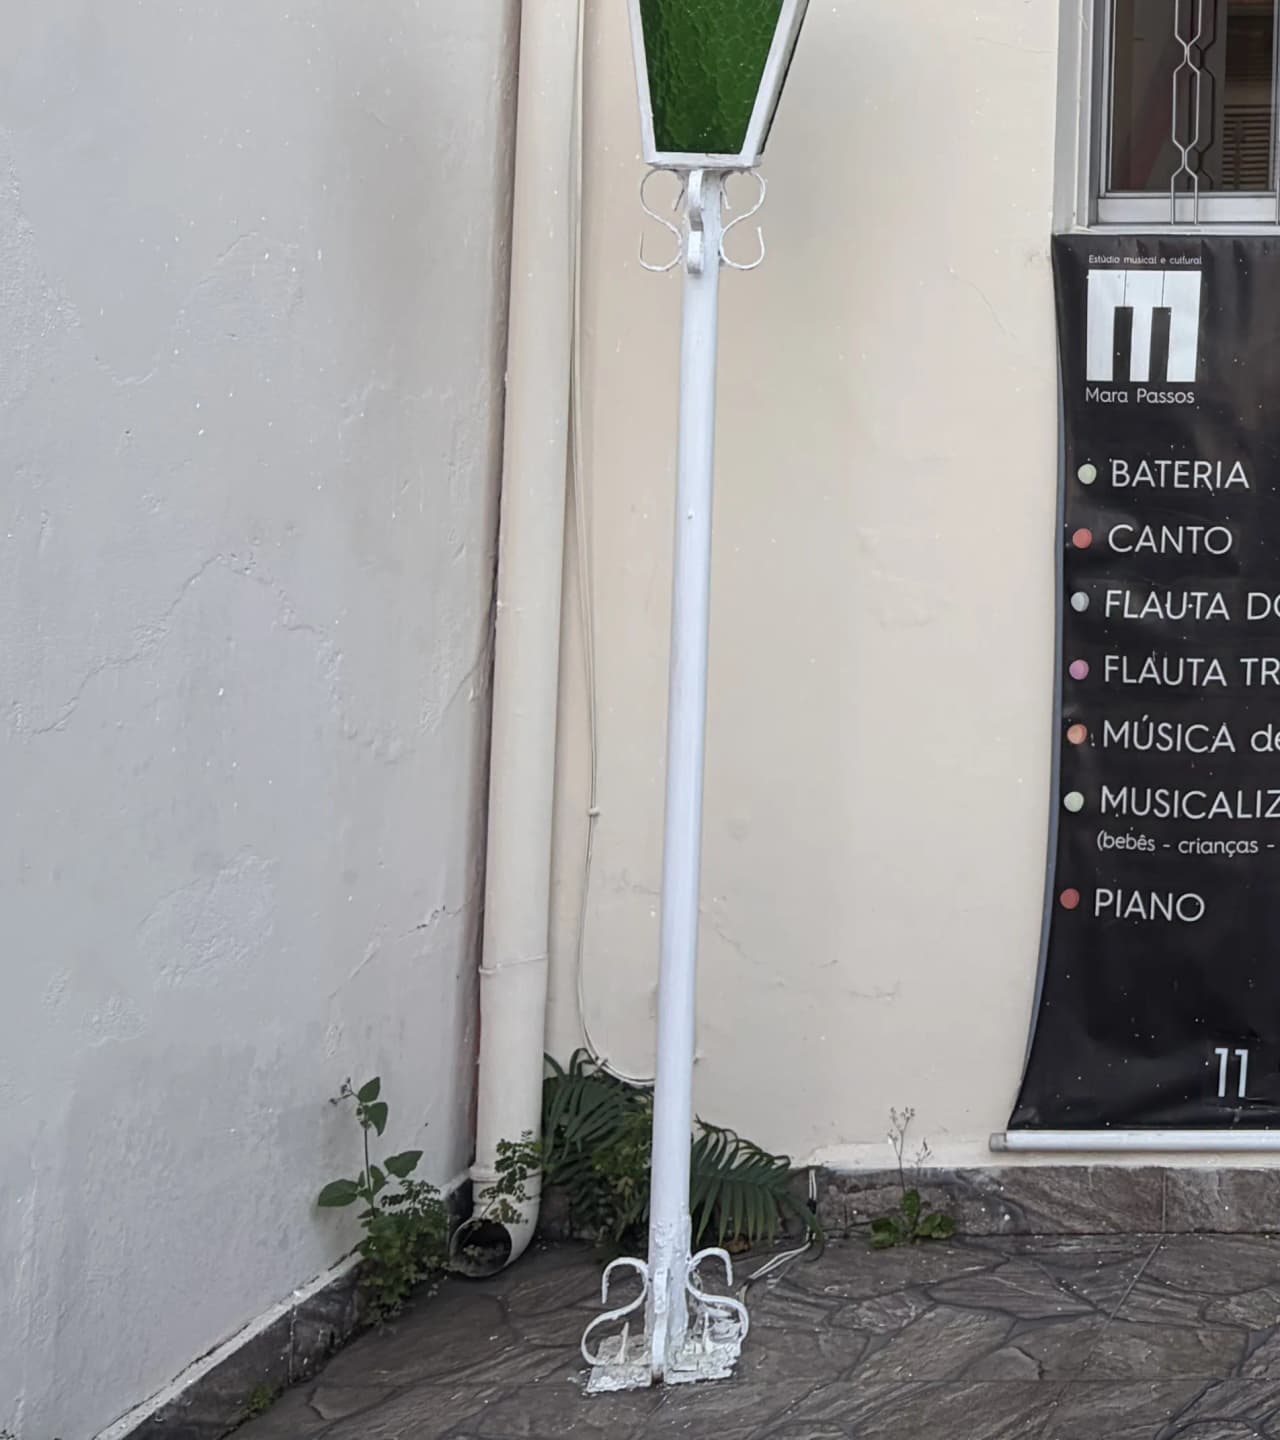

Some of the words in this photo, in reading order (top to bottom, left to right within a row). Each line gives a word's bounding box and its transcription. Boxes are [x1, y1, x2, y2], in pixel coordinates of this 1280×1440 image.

[1088, 254, 1121, 264] Estúdio
[1123, 255, 1157, 265] musical
[1169, 255, 1202, 265] cultural
[1085, 386, 1129, 403] Mara
[1136, 387, 1195, 404] Passos
[1112, 459, 1250, 491] BATERIA
[1108, 524, 1233, 555] CANTO
[1105, 589, 1230, 620] FLAUTA
[1105, 654, 1228, 687] FLAUTA
[1103, 714, 1236, 753] MÚSICA
[1096, 830, 1156, 852] (bebês
[1178, 840, 1259, 858] crianças
[1094, 888, 1205, 922] PIANO
[1214, 1047, 1249, 1098] 11
